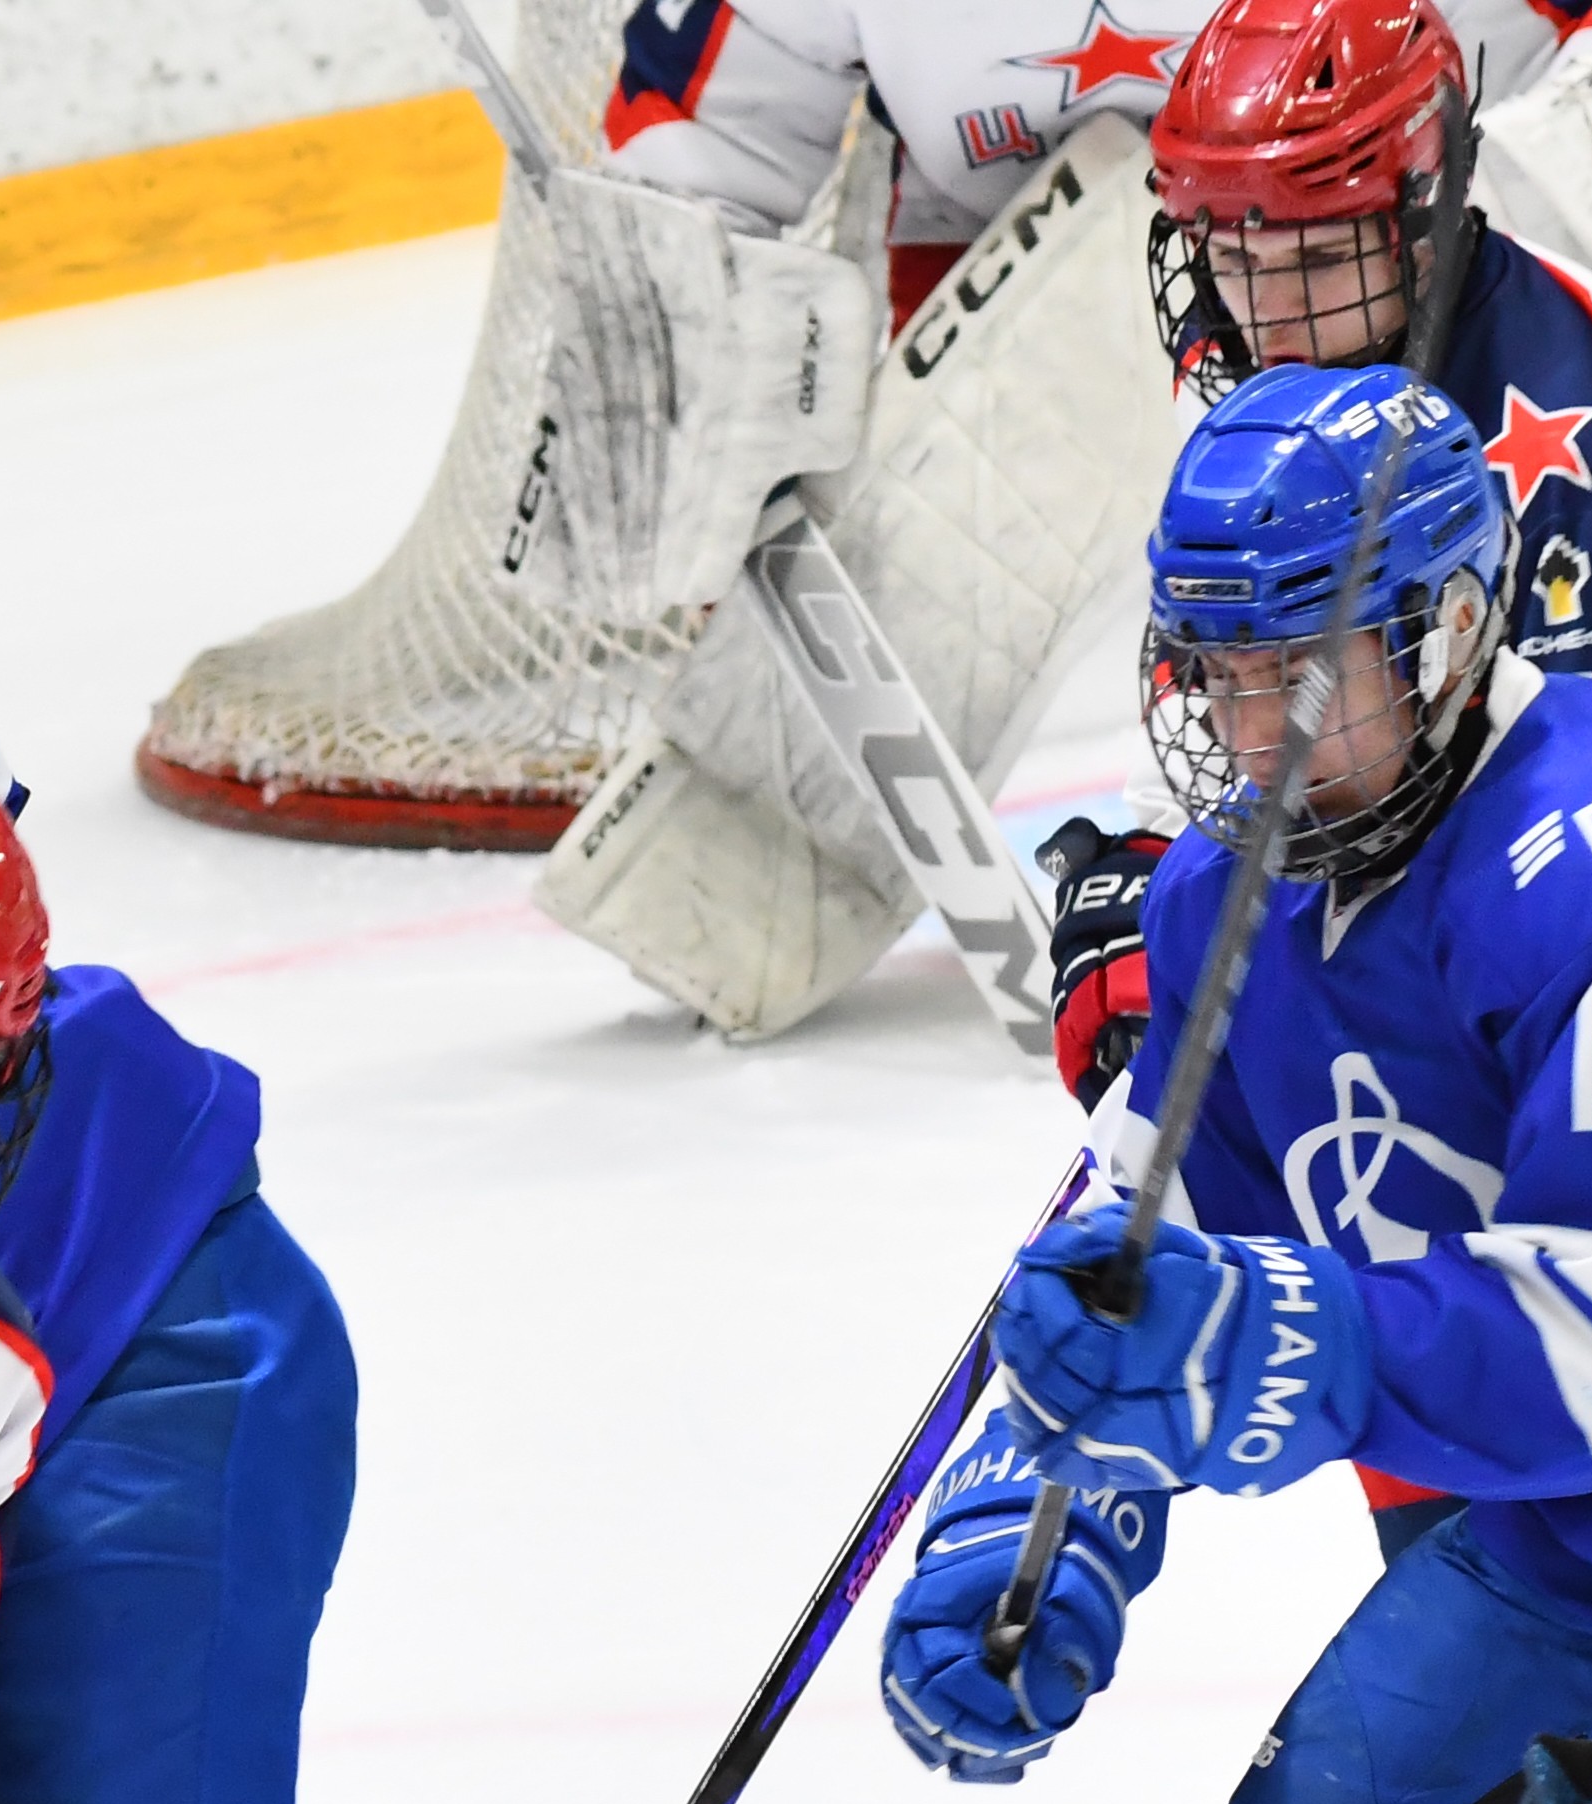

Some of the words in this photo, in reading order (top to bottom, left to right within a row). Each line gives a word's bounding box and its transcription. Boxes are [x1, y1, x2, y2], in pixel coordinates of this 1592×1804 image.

[902, 156, 1085, 380] CCM
[1374, 384, 1451, 438] ВТБ
[503, 413, 560, 574] CCM
